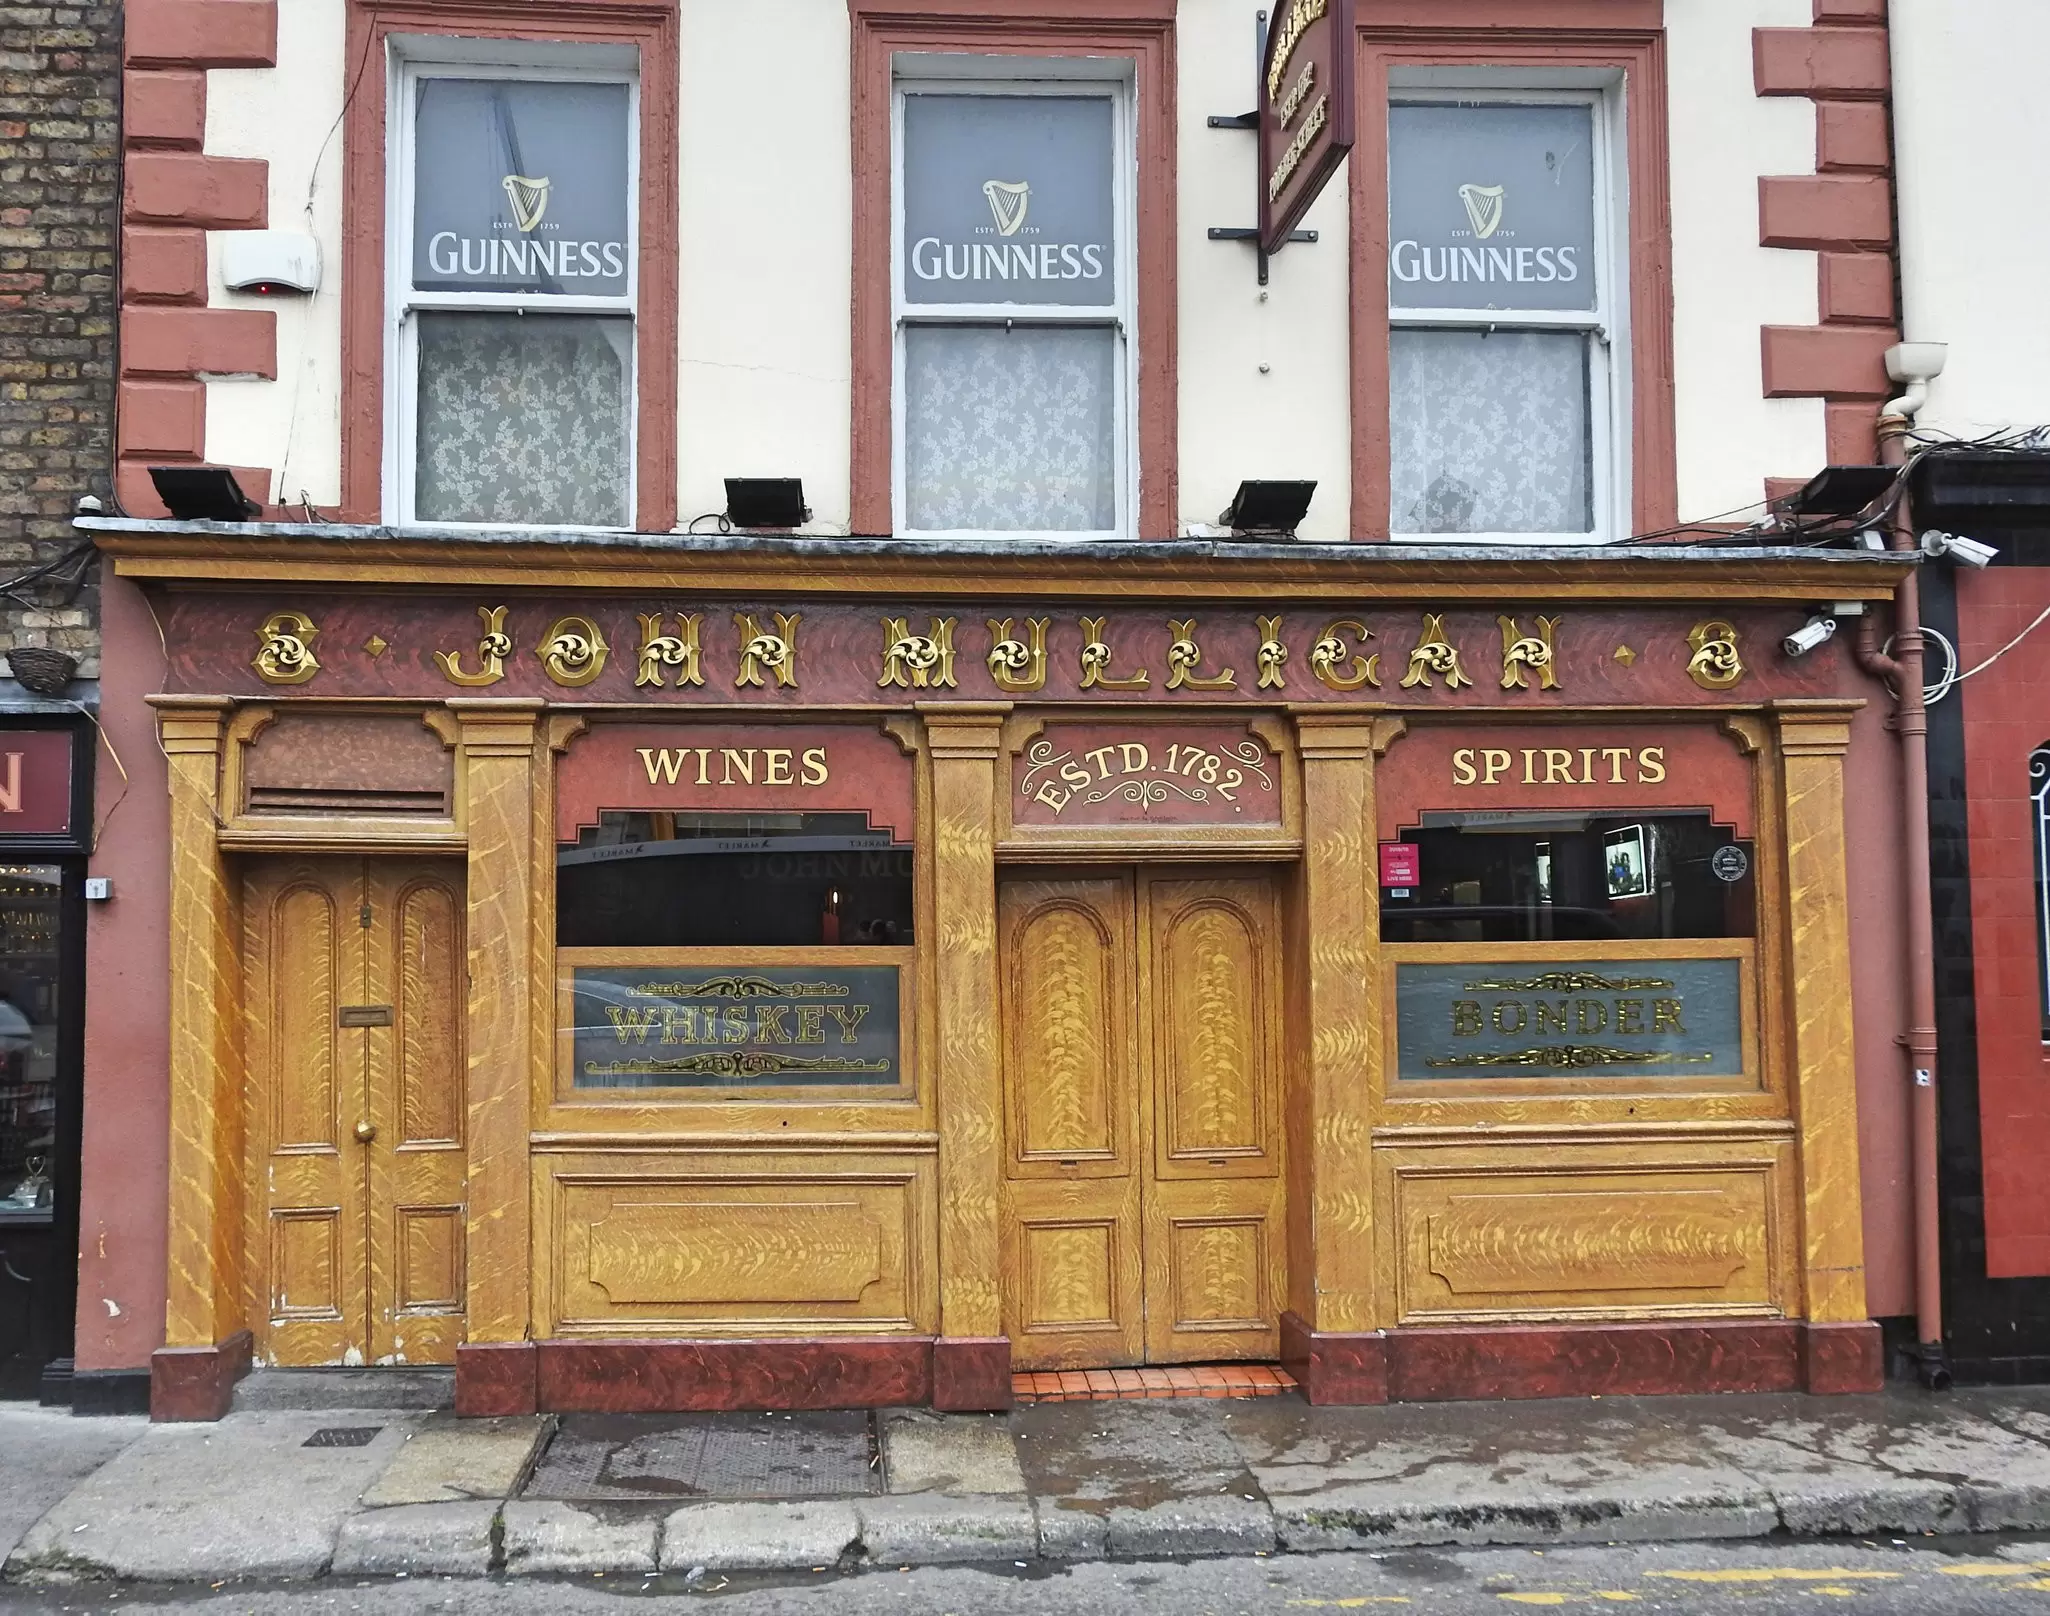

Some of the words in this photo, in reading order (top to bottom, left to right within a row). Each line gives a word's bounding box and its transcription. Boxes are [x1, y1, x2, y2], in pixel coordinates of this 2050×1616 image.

[428, 231, 624, 278] GUINNESS
[911, 237, 1103, 280] GUINNESS
[1391, 240, 1578, 282] GUINNESS
[434, 605, 803, 690] JOHN
[876, 612, 1563, 692] MULLIGAN
[635, 746, 830, 787] WINES
[1451, 746, 1668, 786] SPIRITS
[739, 852, 852, 880] JOHN
[605, 1004, 870, 1045] WHISKEY
[1452, 998, 1688, 1037] BONDER
